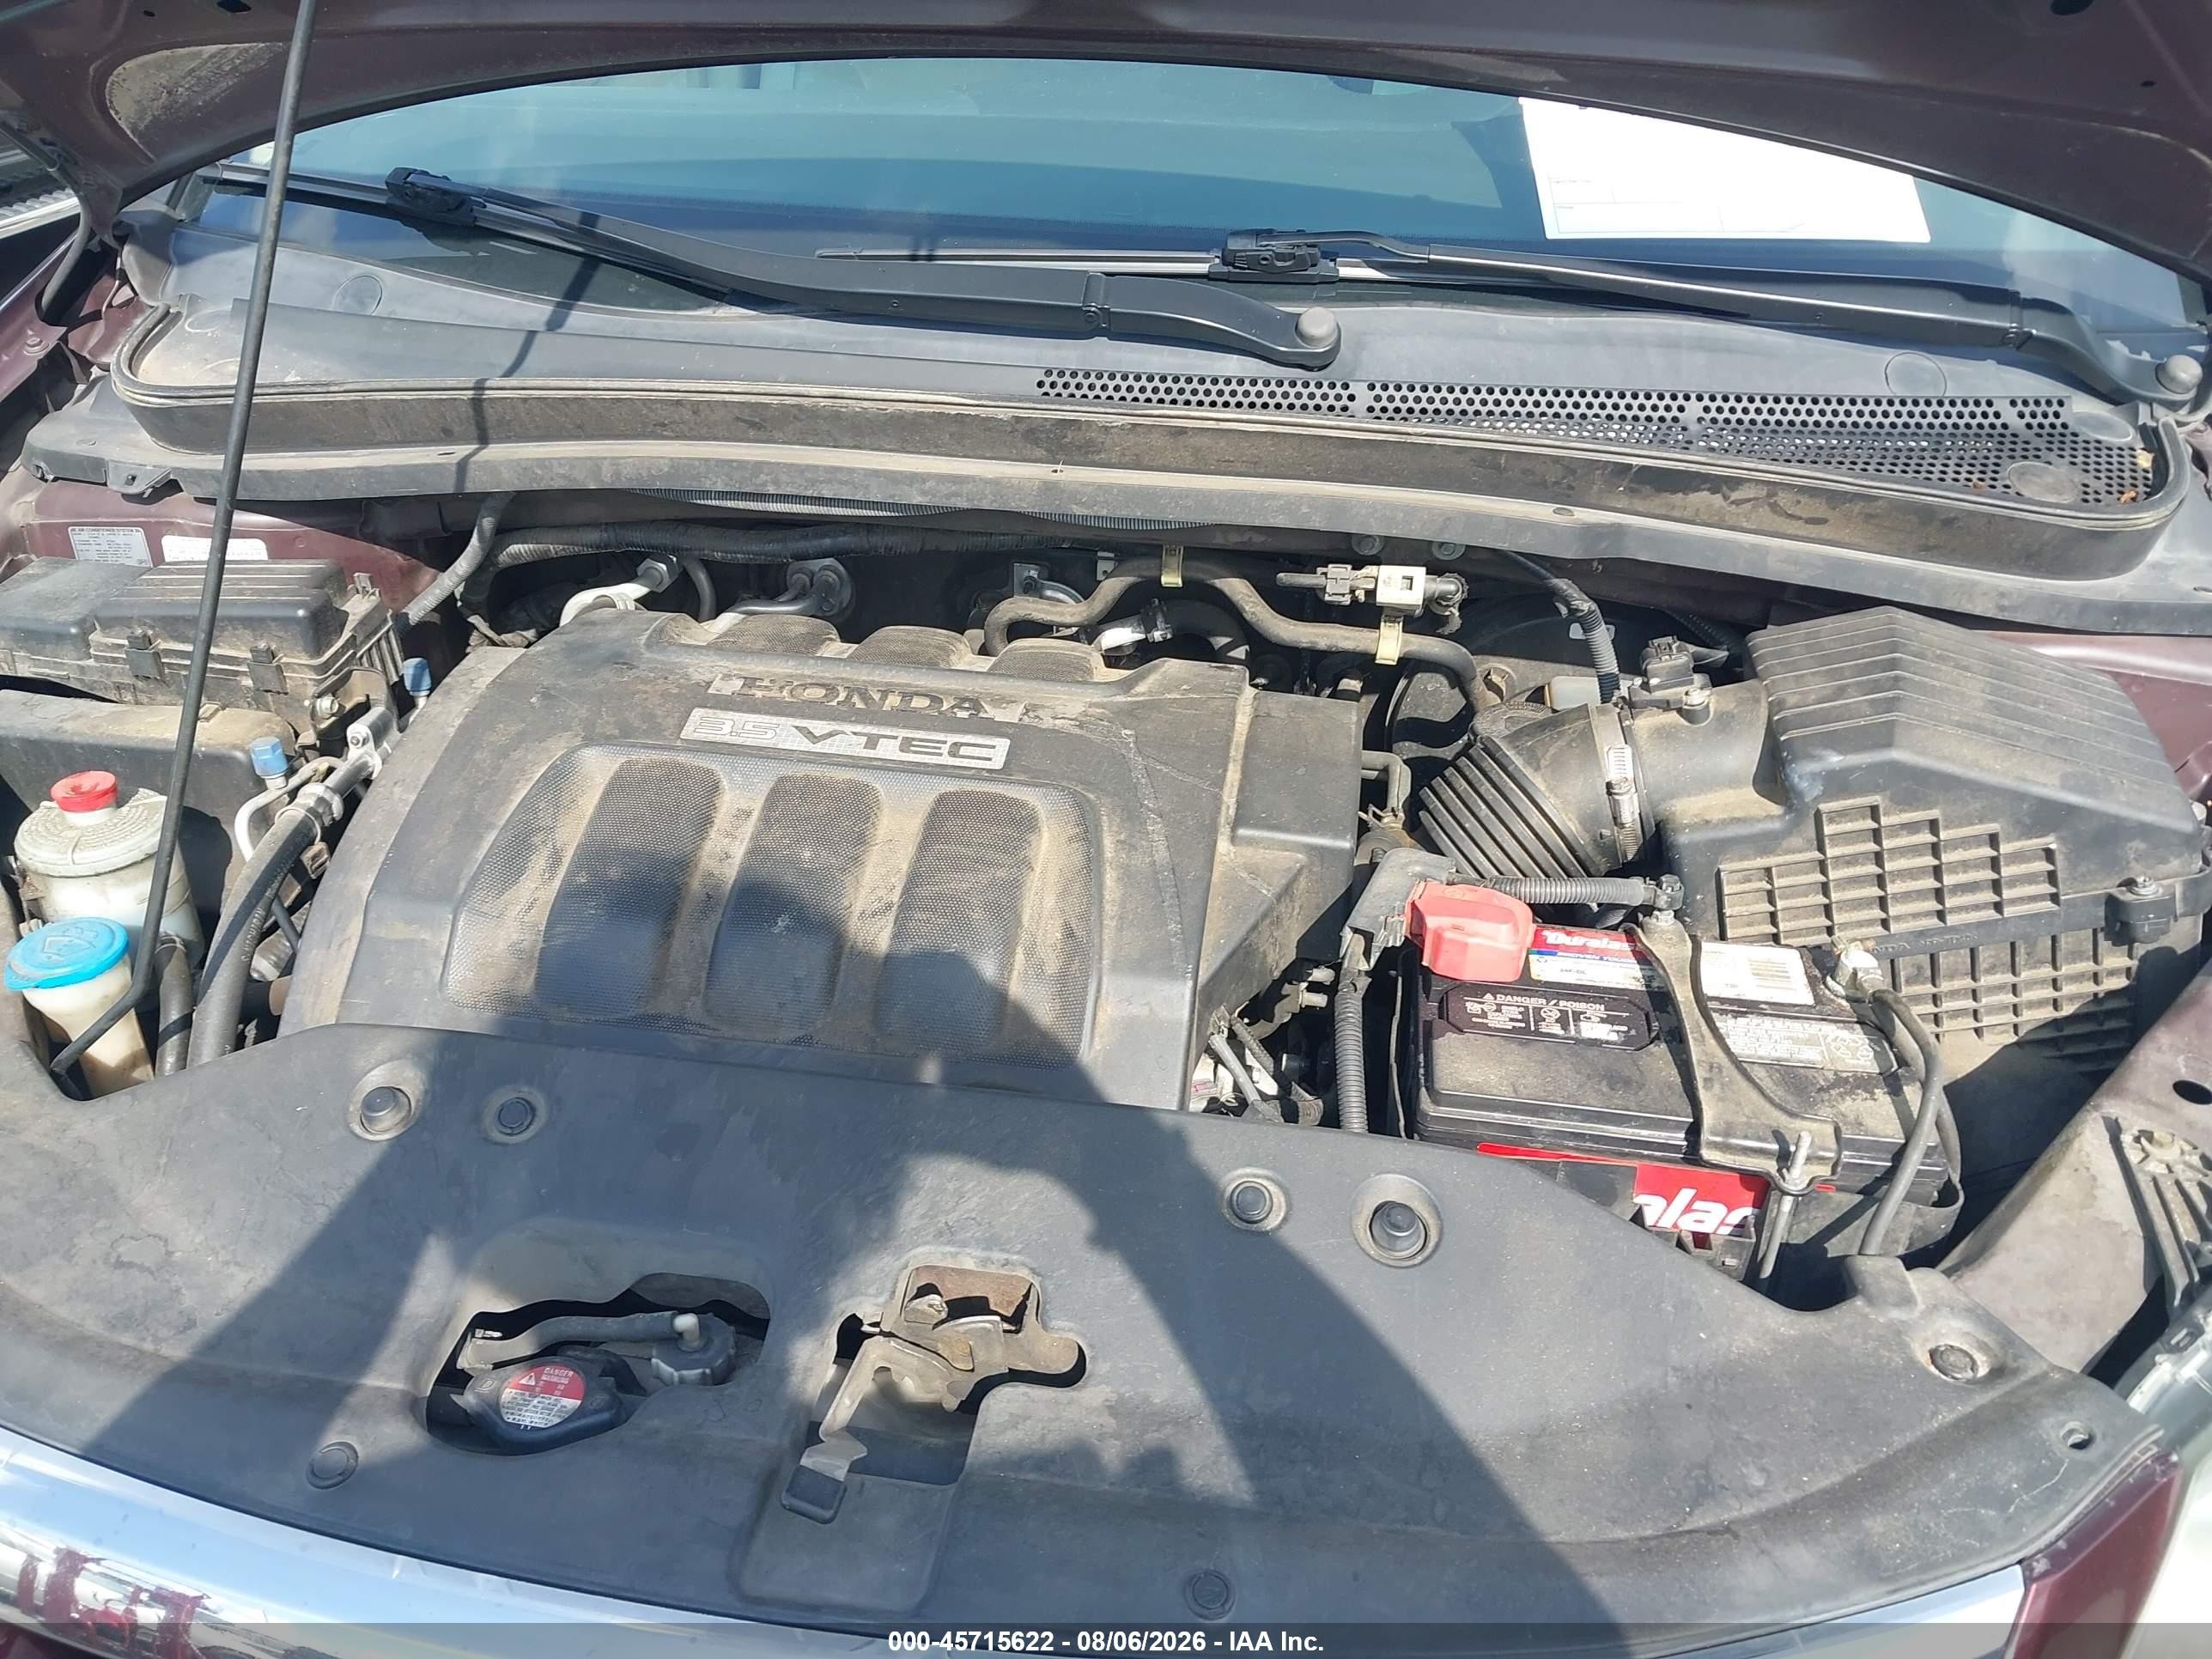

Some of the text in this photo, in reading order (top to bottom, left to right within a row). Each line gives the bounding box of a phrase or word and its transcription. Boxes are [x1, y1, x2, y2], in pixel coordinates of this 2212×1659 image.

[732, 676, 994, 719] HONDA
[694, 717, 996, 762] 3.5 VTEC
[1542, 929, 1635, 951] Duralas
[1497, 994, 1547, 1005] DANGER
[1559, 1000, 1605, 1012] POISON
[544, 1367, 574, 1377] DANGER
